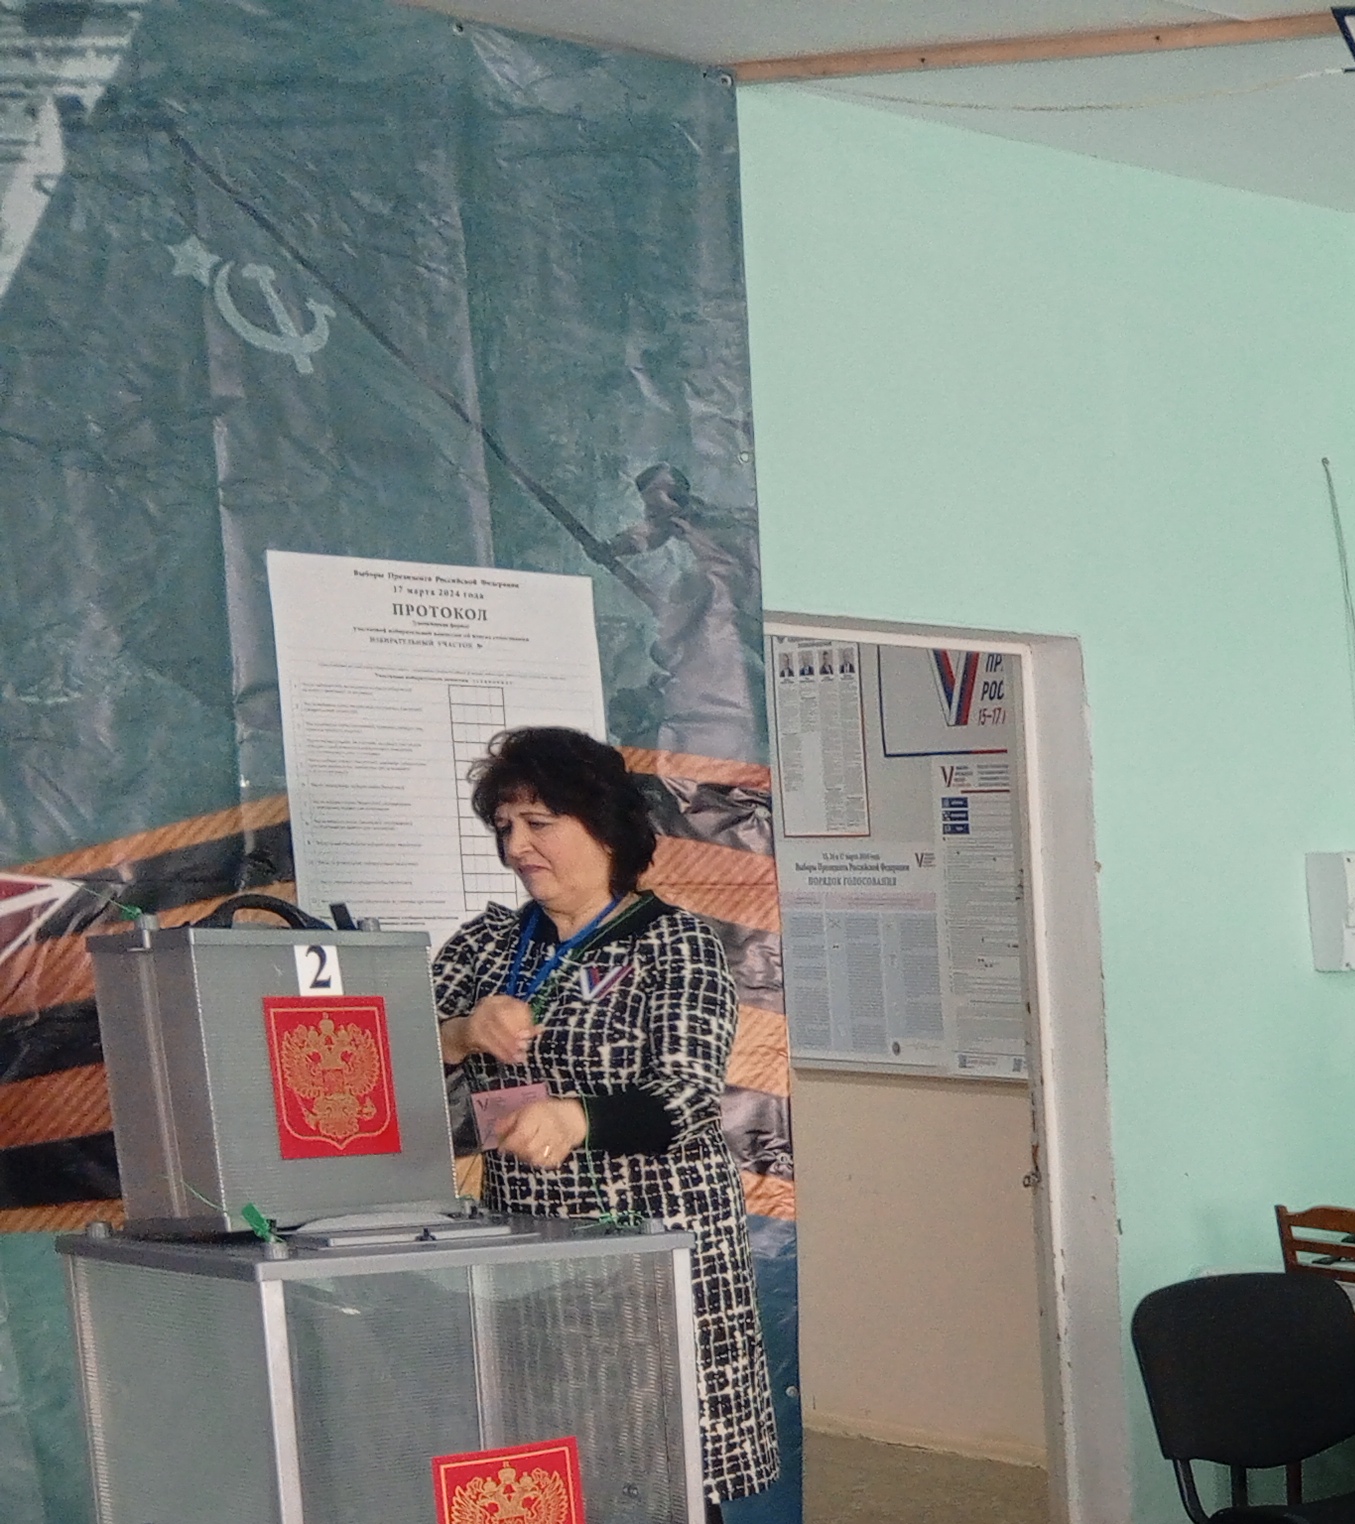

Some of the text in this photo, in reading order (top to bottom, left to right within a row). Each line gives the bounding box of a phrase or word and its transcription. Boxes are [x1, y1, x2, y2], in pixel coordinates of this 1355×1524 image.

[393, 585, 484, 600] 17 марта 2024 года
[392, 602, 488, 621] ПРОТОКОЛ
[986, 654, 1003, 672] ПР
[305, 945, 332, 989] 2
